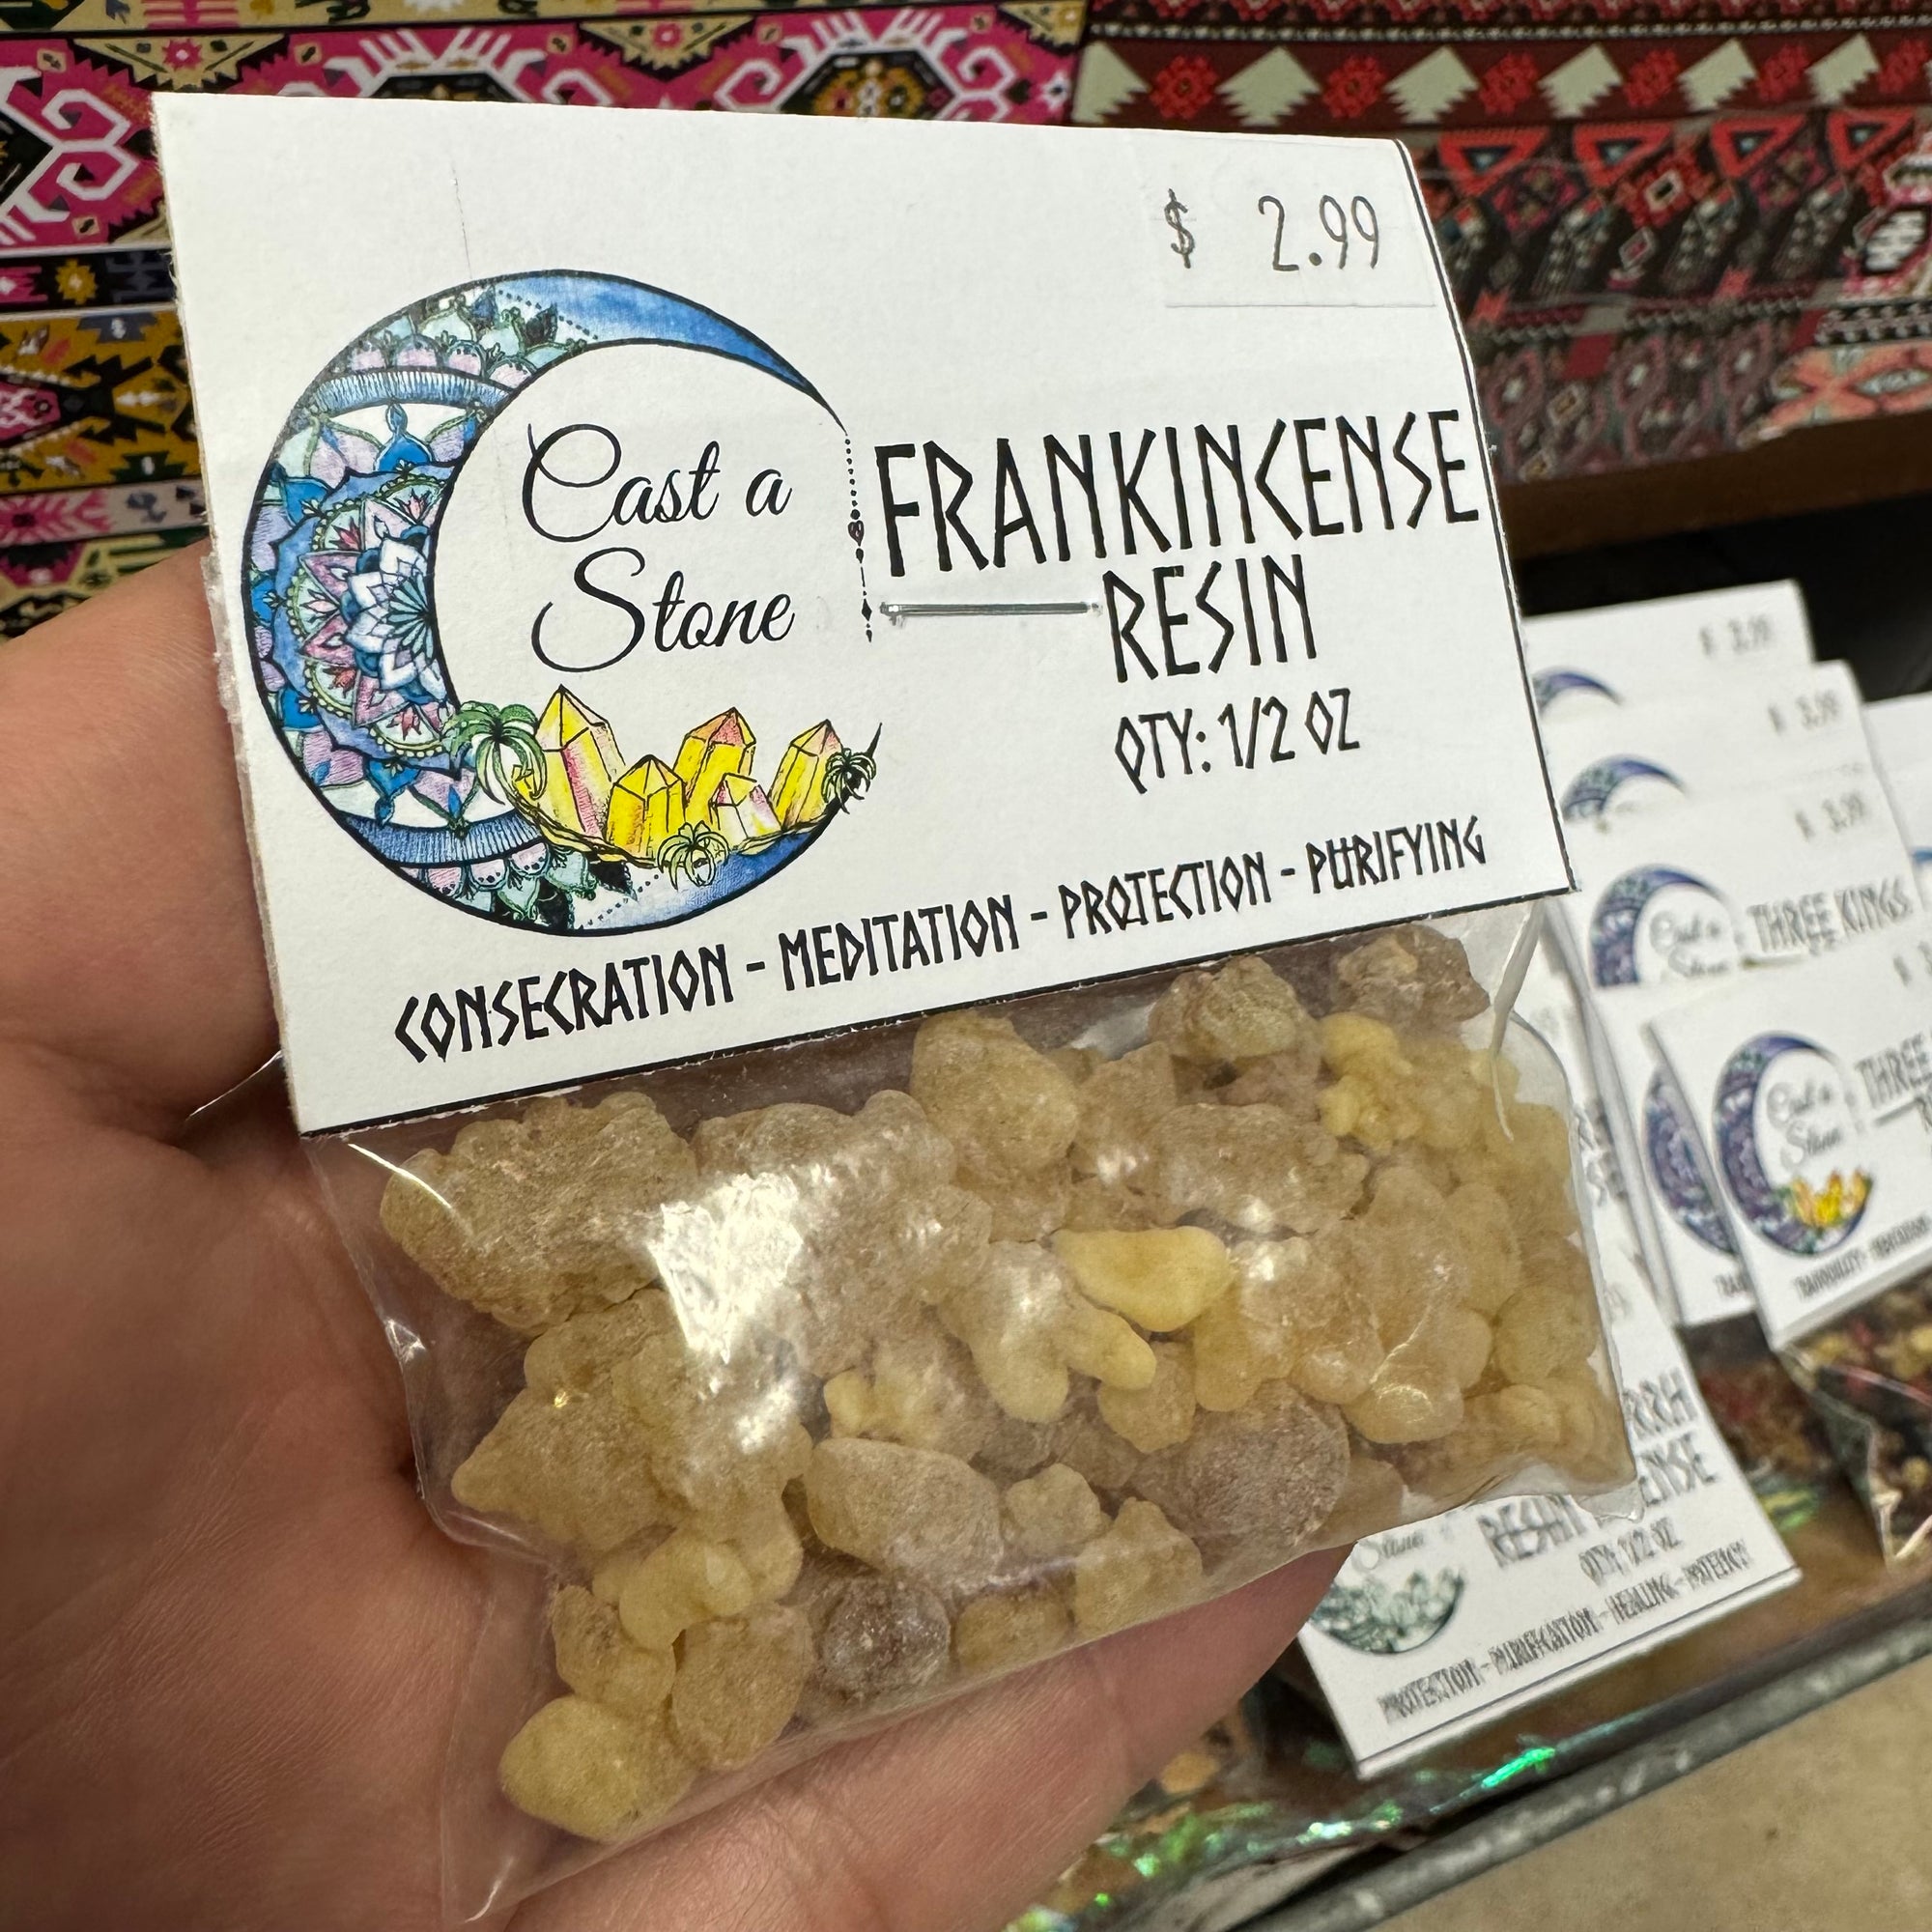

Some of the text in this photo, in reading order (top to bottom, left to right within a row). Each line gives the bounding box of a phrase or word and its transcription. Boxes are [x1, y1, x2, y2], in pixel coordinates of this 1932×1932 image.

[1164, 188, 1379, 271] $ 2.99
[524, 423, 792, 543] Cast a
[874, 409, 1480, 577] FRANKINCENSE
[531, 547, 795, 673] Stone
[1102, 554, 1318, 683] RESIN
[1114, 688, 1360, 794] QTY: 1/2 OZ
[393, 944, 734, 1064] CONSECRATION
[778, 894, 1020, 992] MEDITATION
[1058, 851, 1273, 939] PROTECTION
[1306, 815, 1487, 895] PURIFYING
[1747, 876, 1913, 952] THREE KINGS
[1854, 1032, 1932, 1109] THREE
